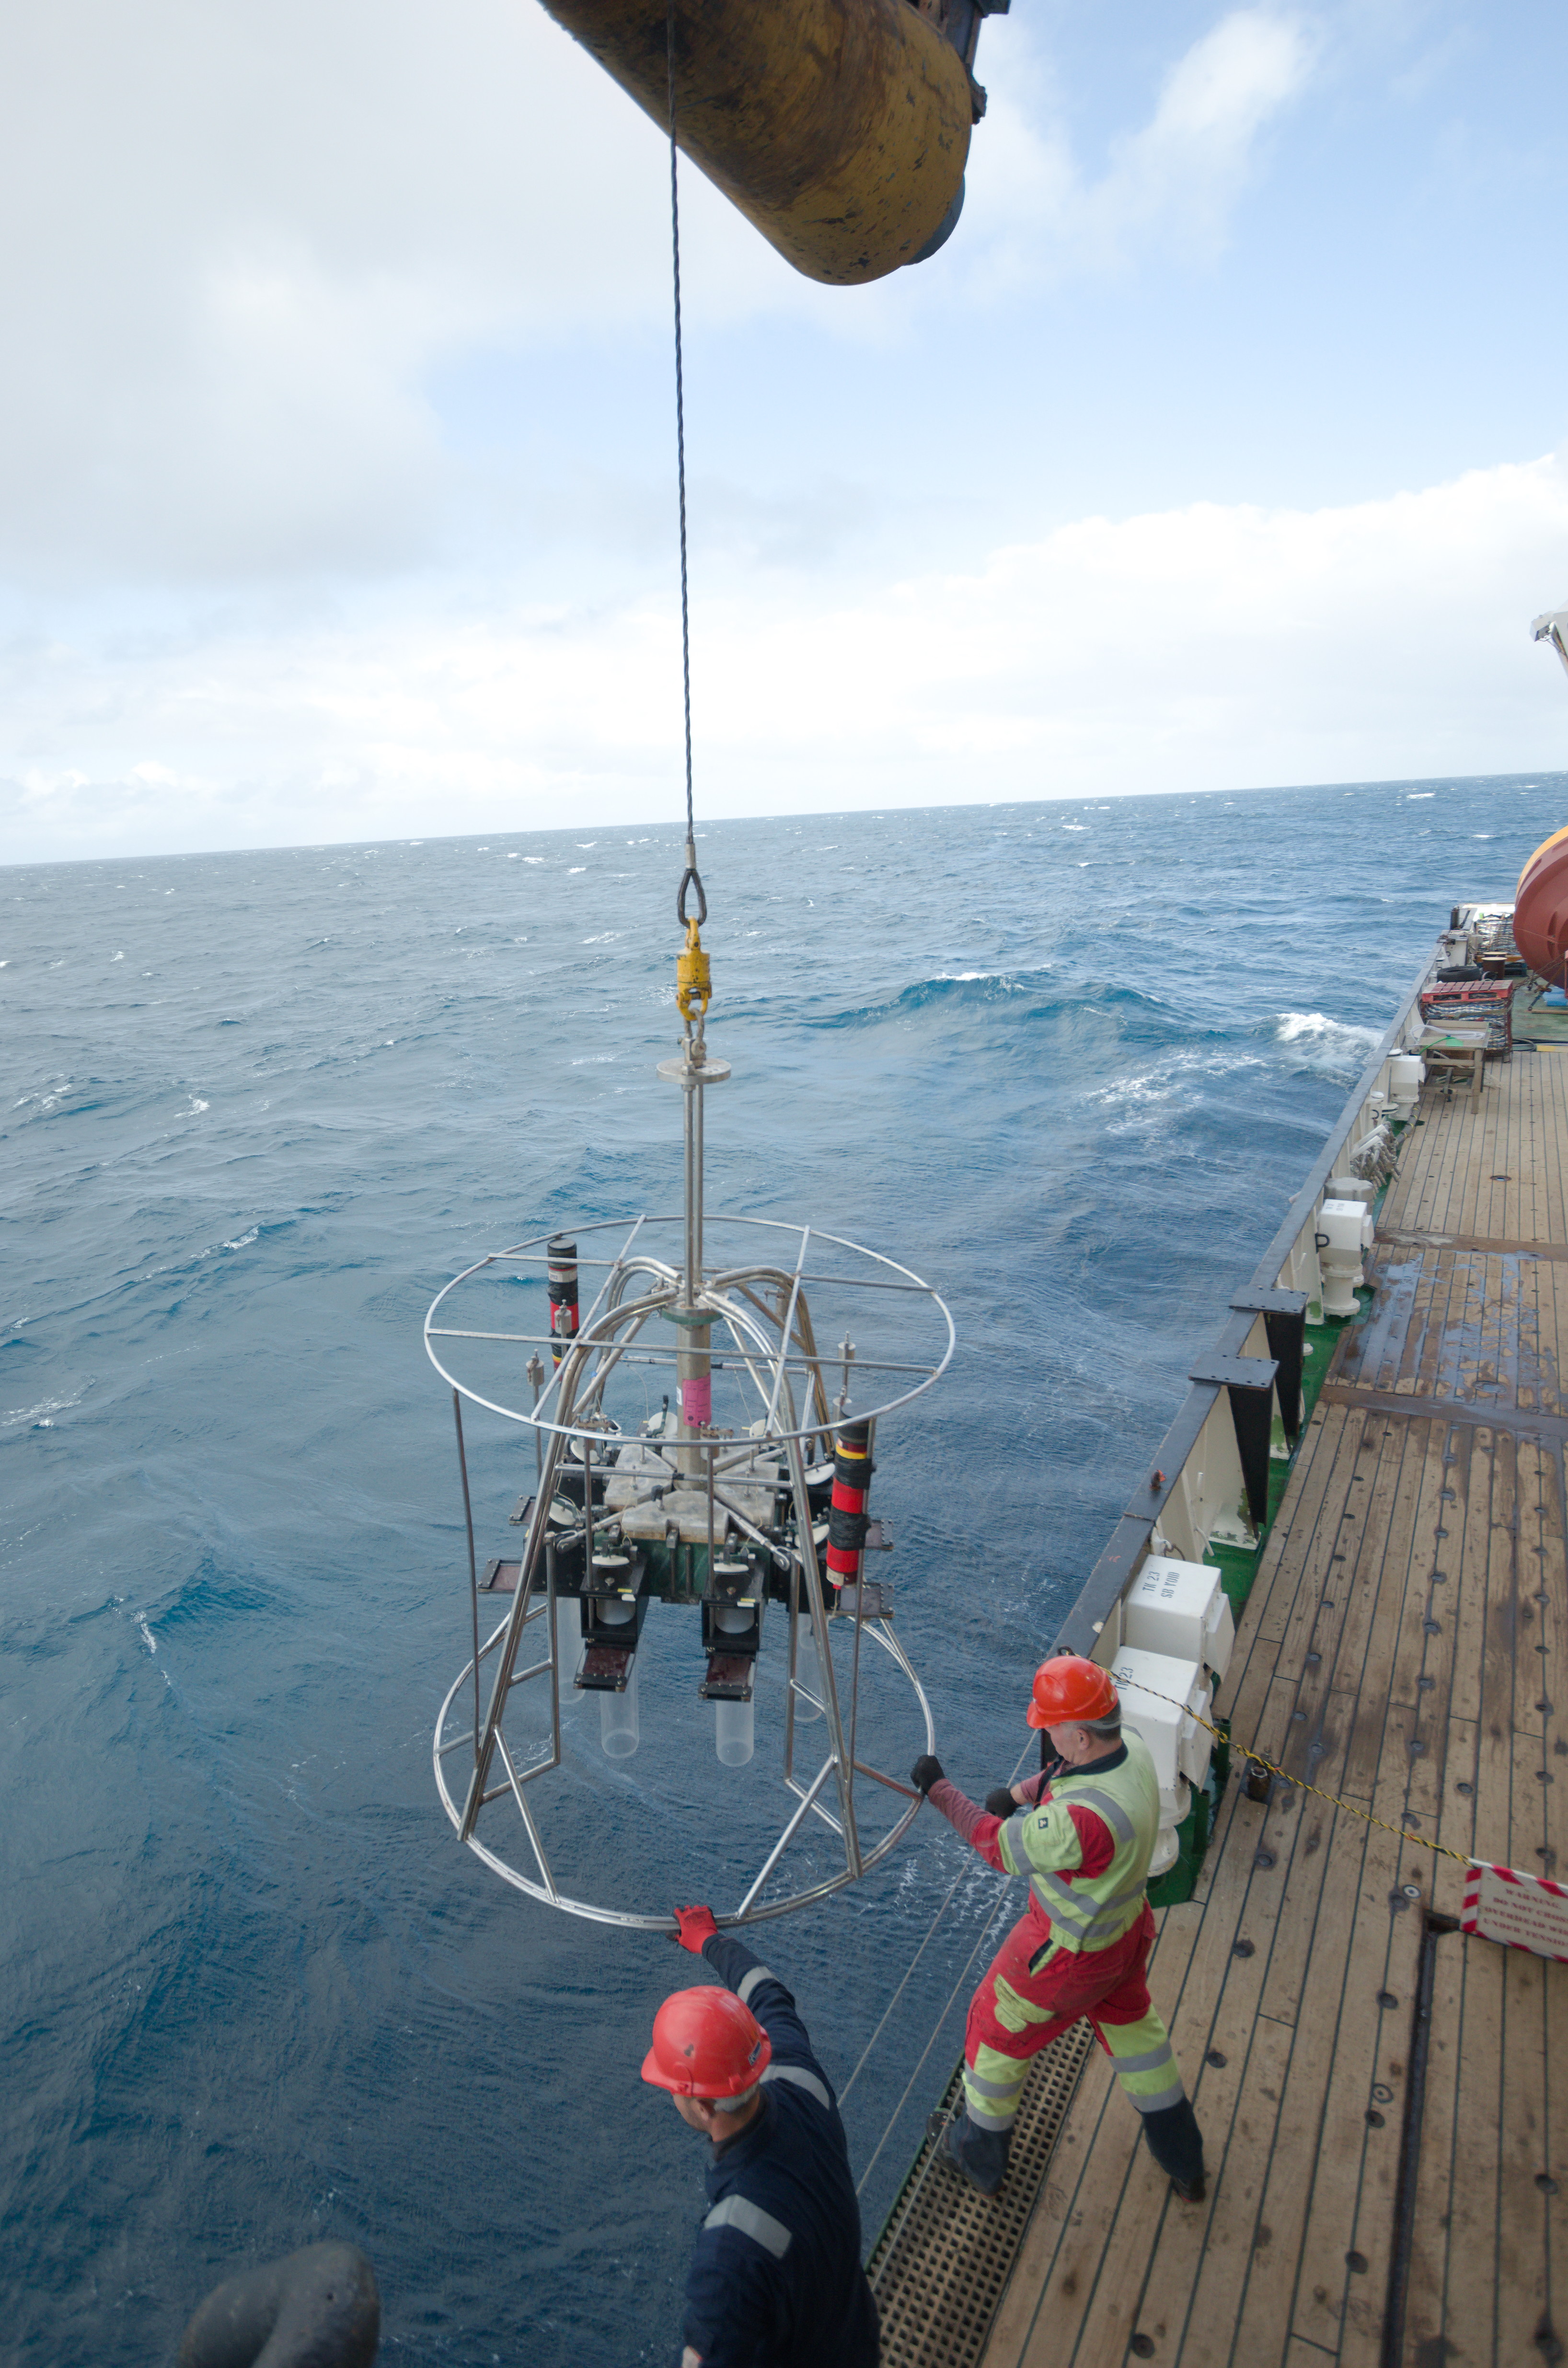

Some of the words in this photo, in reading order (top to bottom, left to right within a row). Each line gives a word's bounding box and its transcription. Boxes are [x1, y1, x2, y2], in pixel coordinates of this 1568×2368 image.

[1147, 1571, 1160, 1581] 23
[1164, 1572, 1180, 1586] VOID
[1142, 1582, 1157, 1591] TK
[1161, 1589, 1174, 1598] SB
[1118, 1667, 1134, 1679] 23
[1493, 1897, 1509, 1905] DO
[1512, 1902, 1533, 1913] NOT
[1536, 1910, 1568, 1923] CROS
[1485, 1906, 1545, 1928] OVERHEAD
[1483, 1917, 1521, 1933] UNDER
[1525, 1929, 1568, 1947] TENSIO
